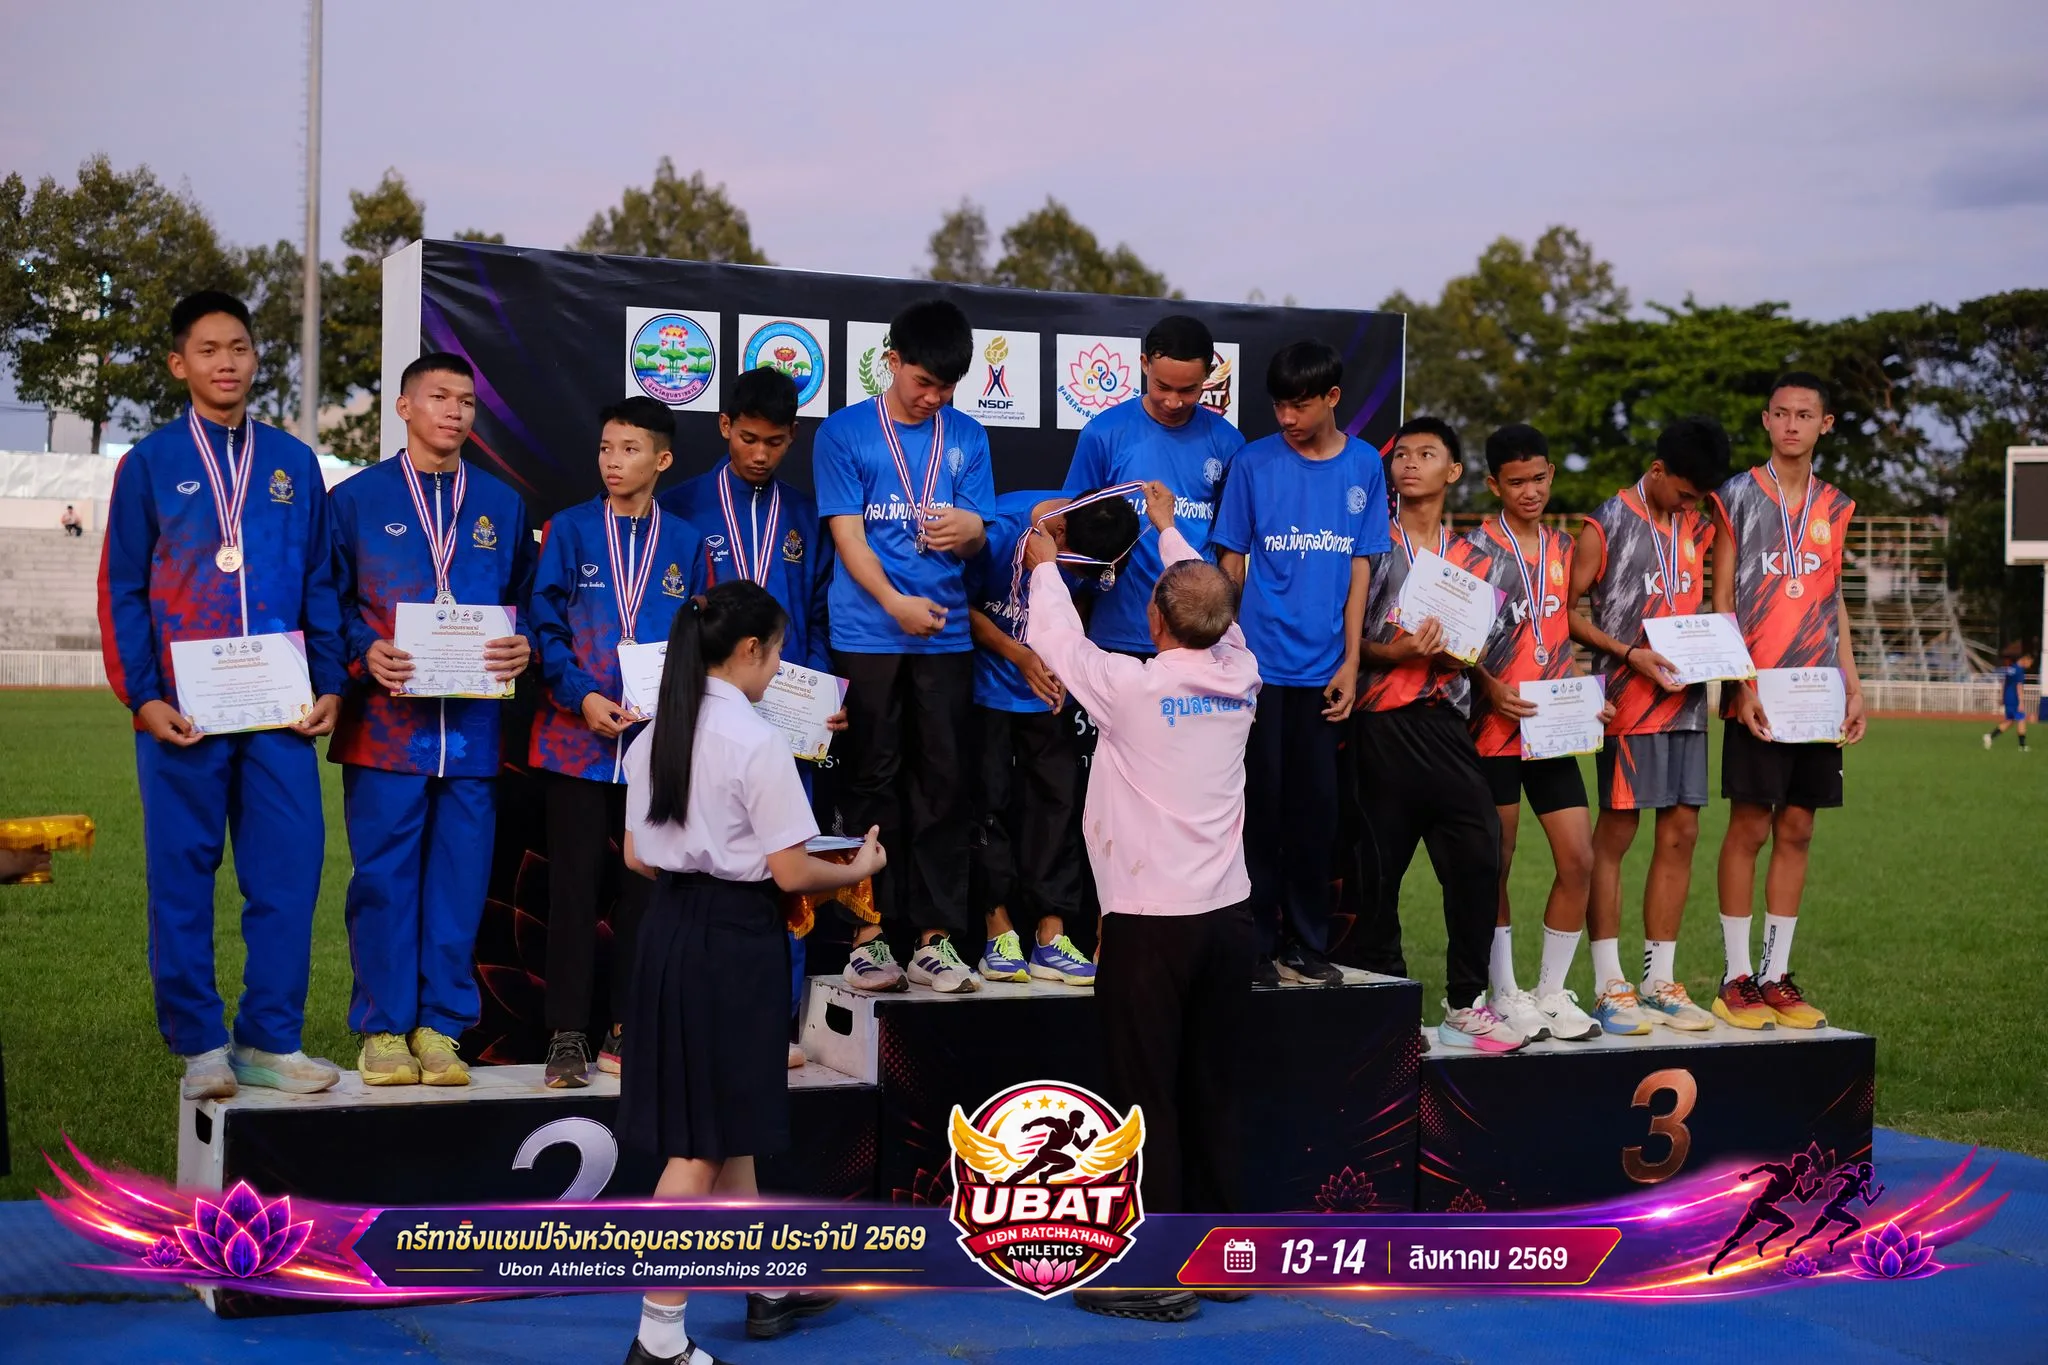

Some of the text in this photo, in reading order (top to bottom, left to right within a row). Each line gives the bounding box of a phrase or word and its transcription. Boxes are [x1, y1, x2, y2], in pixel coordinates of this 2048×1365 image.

[978, 399, 1014, 409] NSDF
[1199, 390, 1226, 407] AT
[1644, 570, 1692, 595] KP
[1511, 595, 1560, 624] KP
[1622, 1068, 1698, 1184] 3
[512, 1116, 619, 1203] 2
